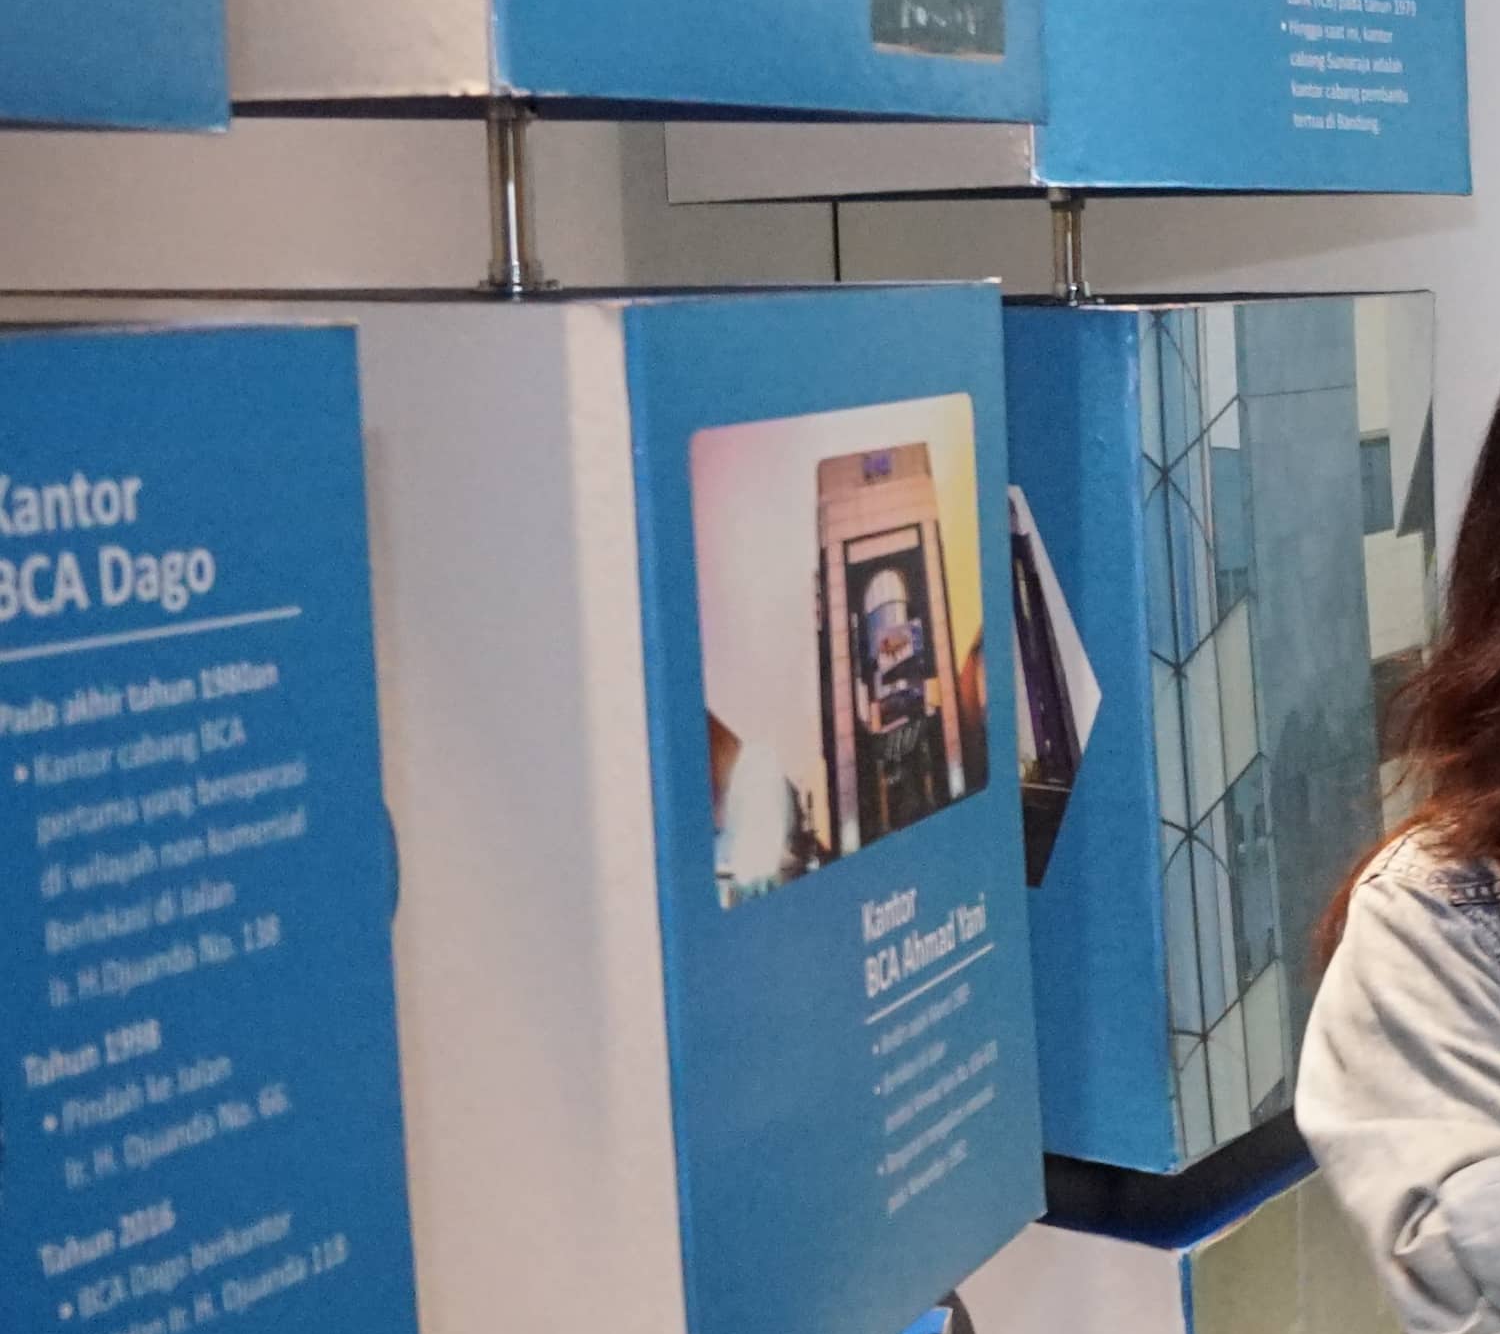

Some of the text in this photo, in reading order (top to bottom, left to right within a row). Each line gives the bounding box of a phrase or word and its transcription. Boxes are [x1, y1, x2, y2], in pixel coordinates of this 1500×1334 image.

[0, 545, 215, 622] BCA Dago
[200, 715, 246, 753] BCA
[862, 887, 917, 943] Kantor
[865, 891, 987, 998] BCA Ahmad Yani
[78, 1274, 127, 1318] BCA
